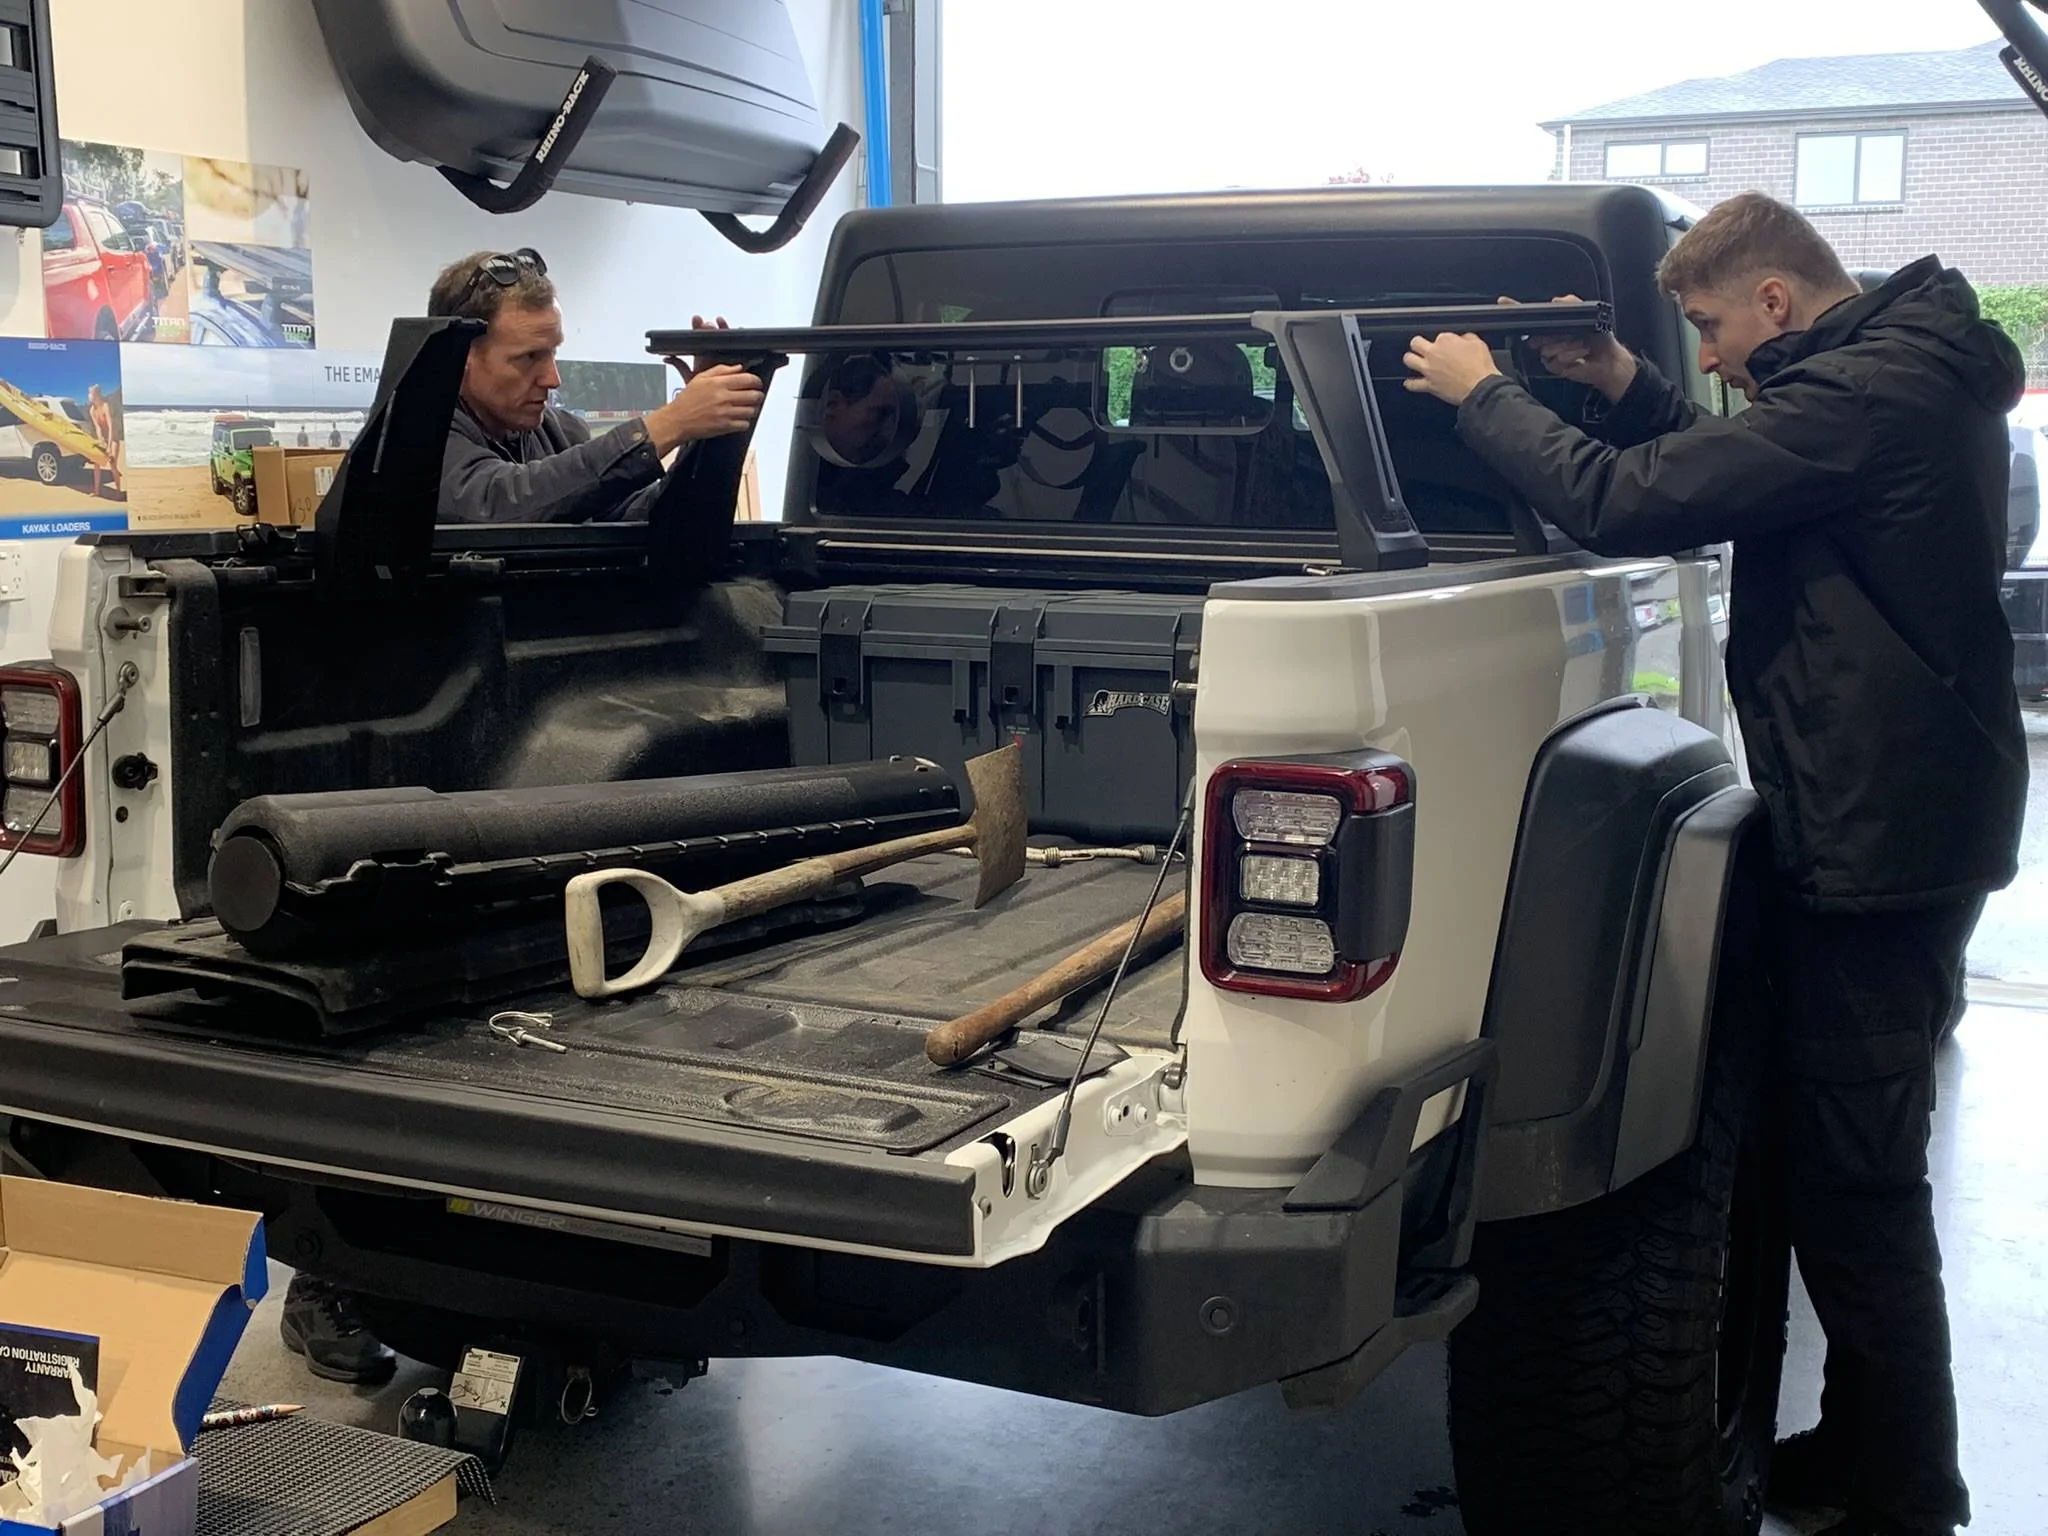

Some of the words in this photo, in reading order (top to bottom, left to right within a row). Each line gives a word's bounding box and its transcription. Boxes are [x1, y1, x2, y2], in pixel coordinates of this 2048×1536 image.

[2013, 57, 2048, 102] RHINO
[535, 69, 590, 164] RHINO-RACK
[324, 366, 351, 382] THE
[22, 524, 50, 535] KAYAK
[51, 521, 91, 533] LOADERS
[474, 1203, 566, 1230] WINGER
[25, 1361, 73, 1379] ARRANTY
